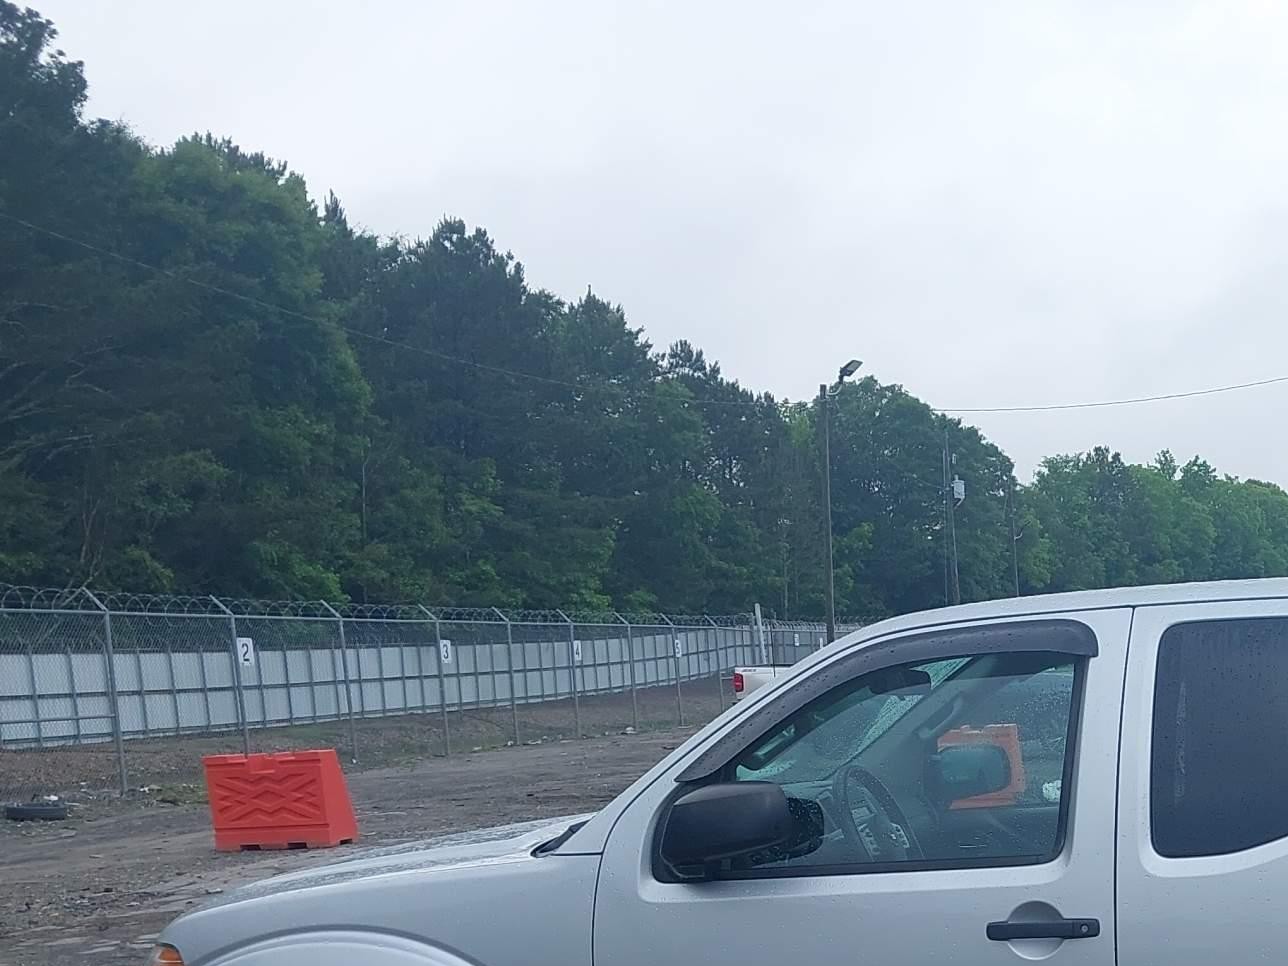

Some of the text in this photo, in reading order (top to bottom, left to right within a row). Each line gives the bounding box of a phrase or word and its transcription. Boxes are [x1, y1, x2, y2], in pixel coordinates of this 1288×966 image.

[241, 643, 250, 662] 2
[442, 644, 449, 660] 3
[575, 642, 580, 658] 4
